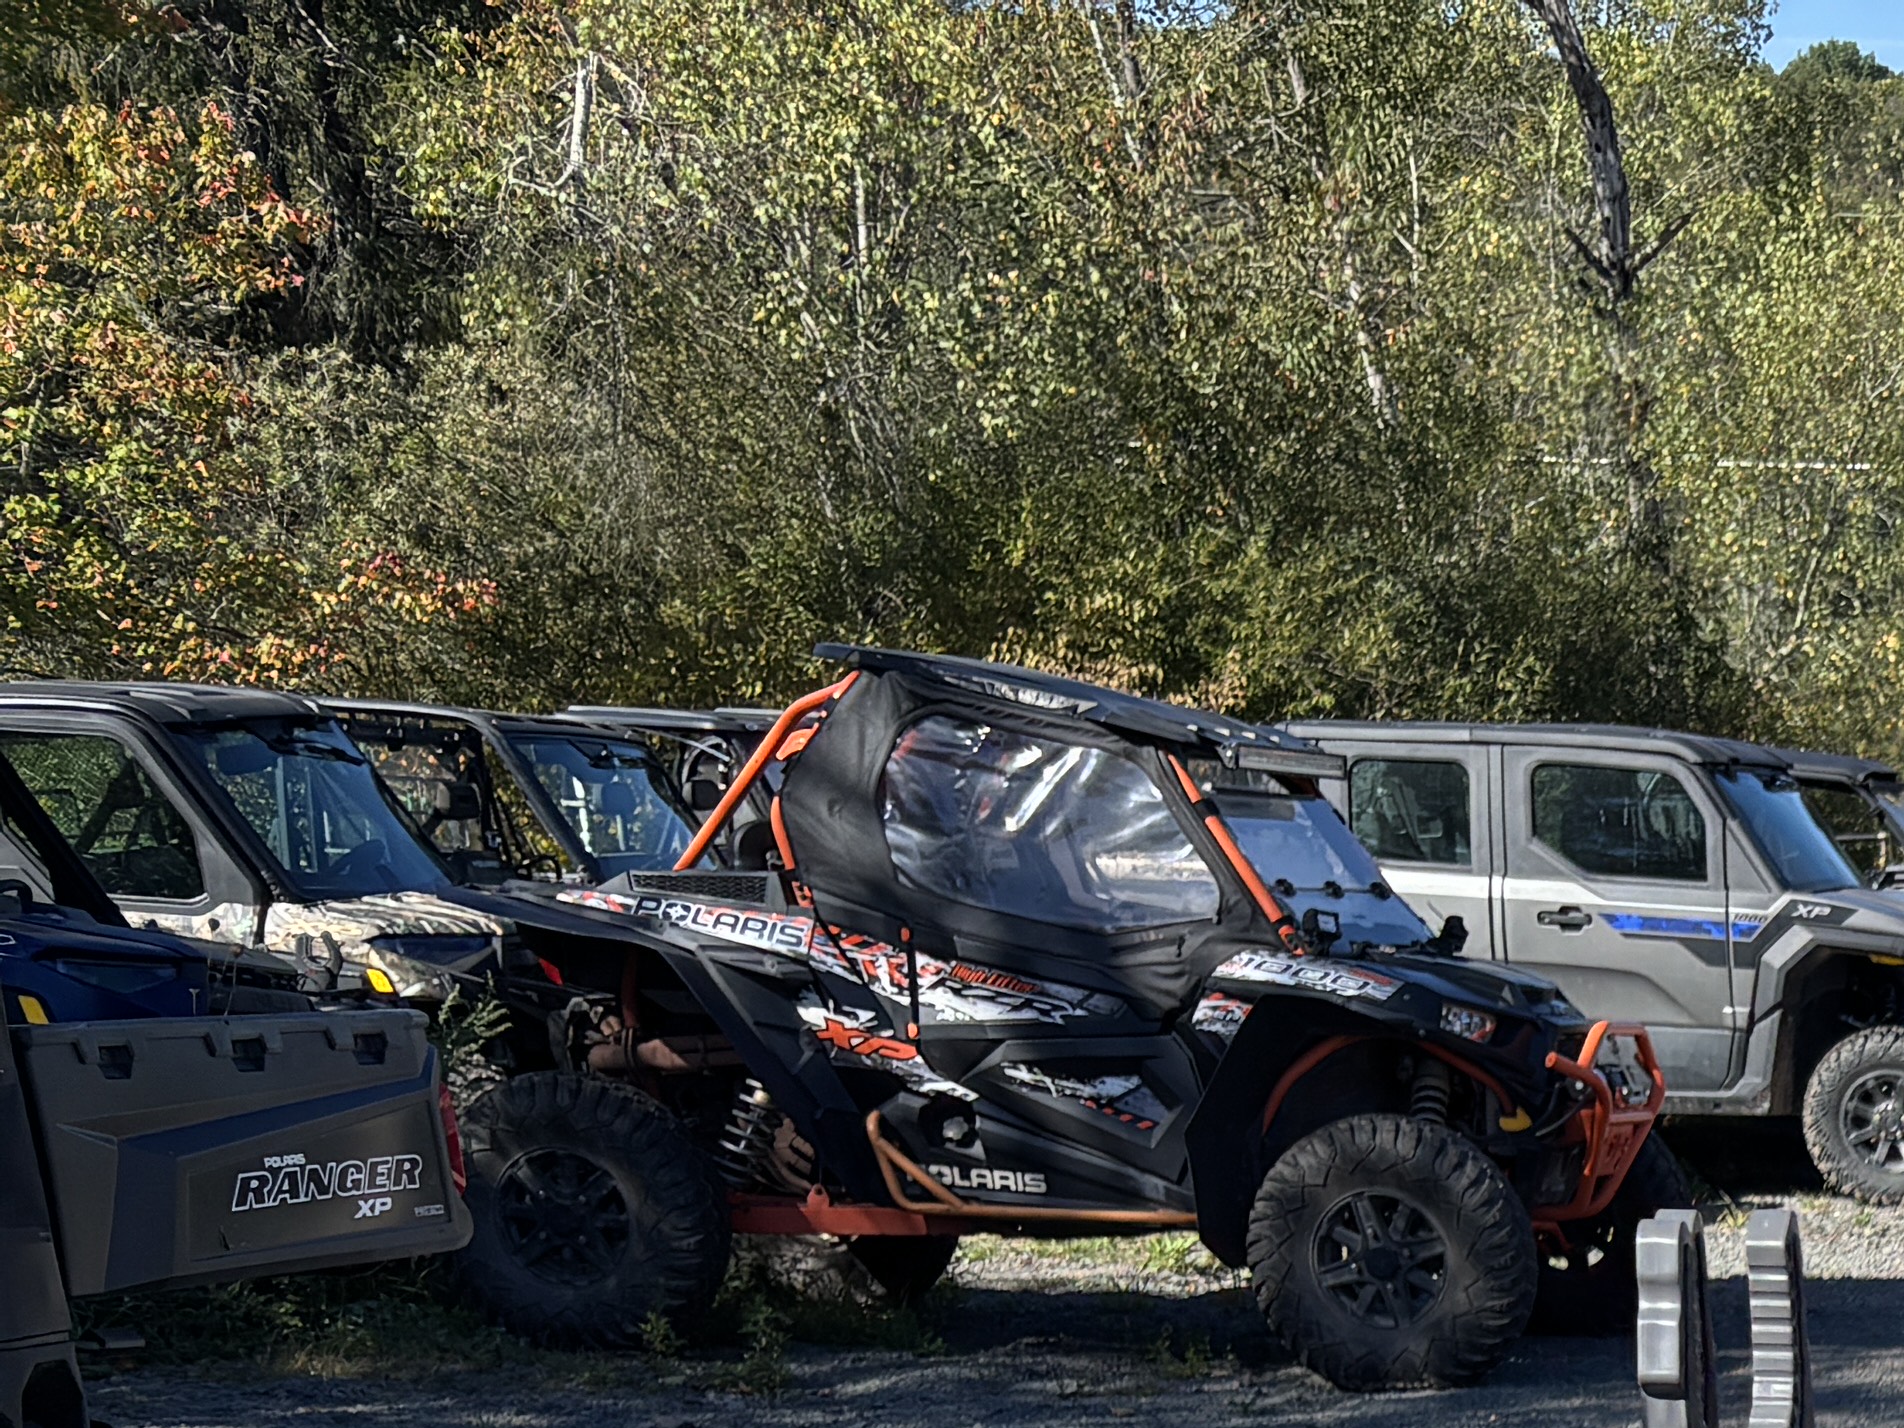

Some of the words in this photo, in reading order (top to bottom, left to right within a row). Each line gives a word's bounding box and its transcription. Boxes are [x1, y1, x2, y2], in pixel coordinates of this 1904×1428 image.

[633, 895, 806, 947] POLARIS
[1791, 903, 1832, 919] XP
[815, 1016, 919, 1060] XP
[263, 1153, 306, 1168] POLARIS
[231, 1153, 423, 1212] RANGER
[907, 1163, 1047, 1194] OLARIS
[354, 1197, 392, 1218] XP
